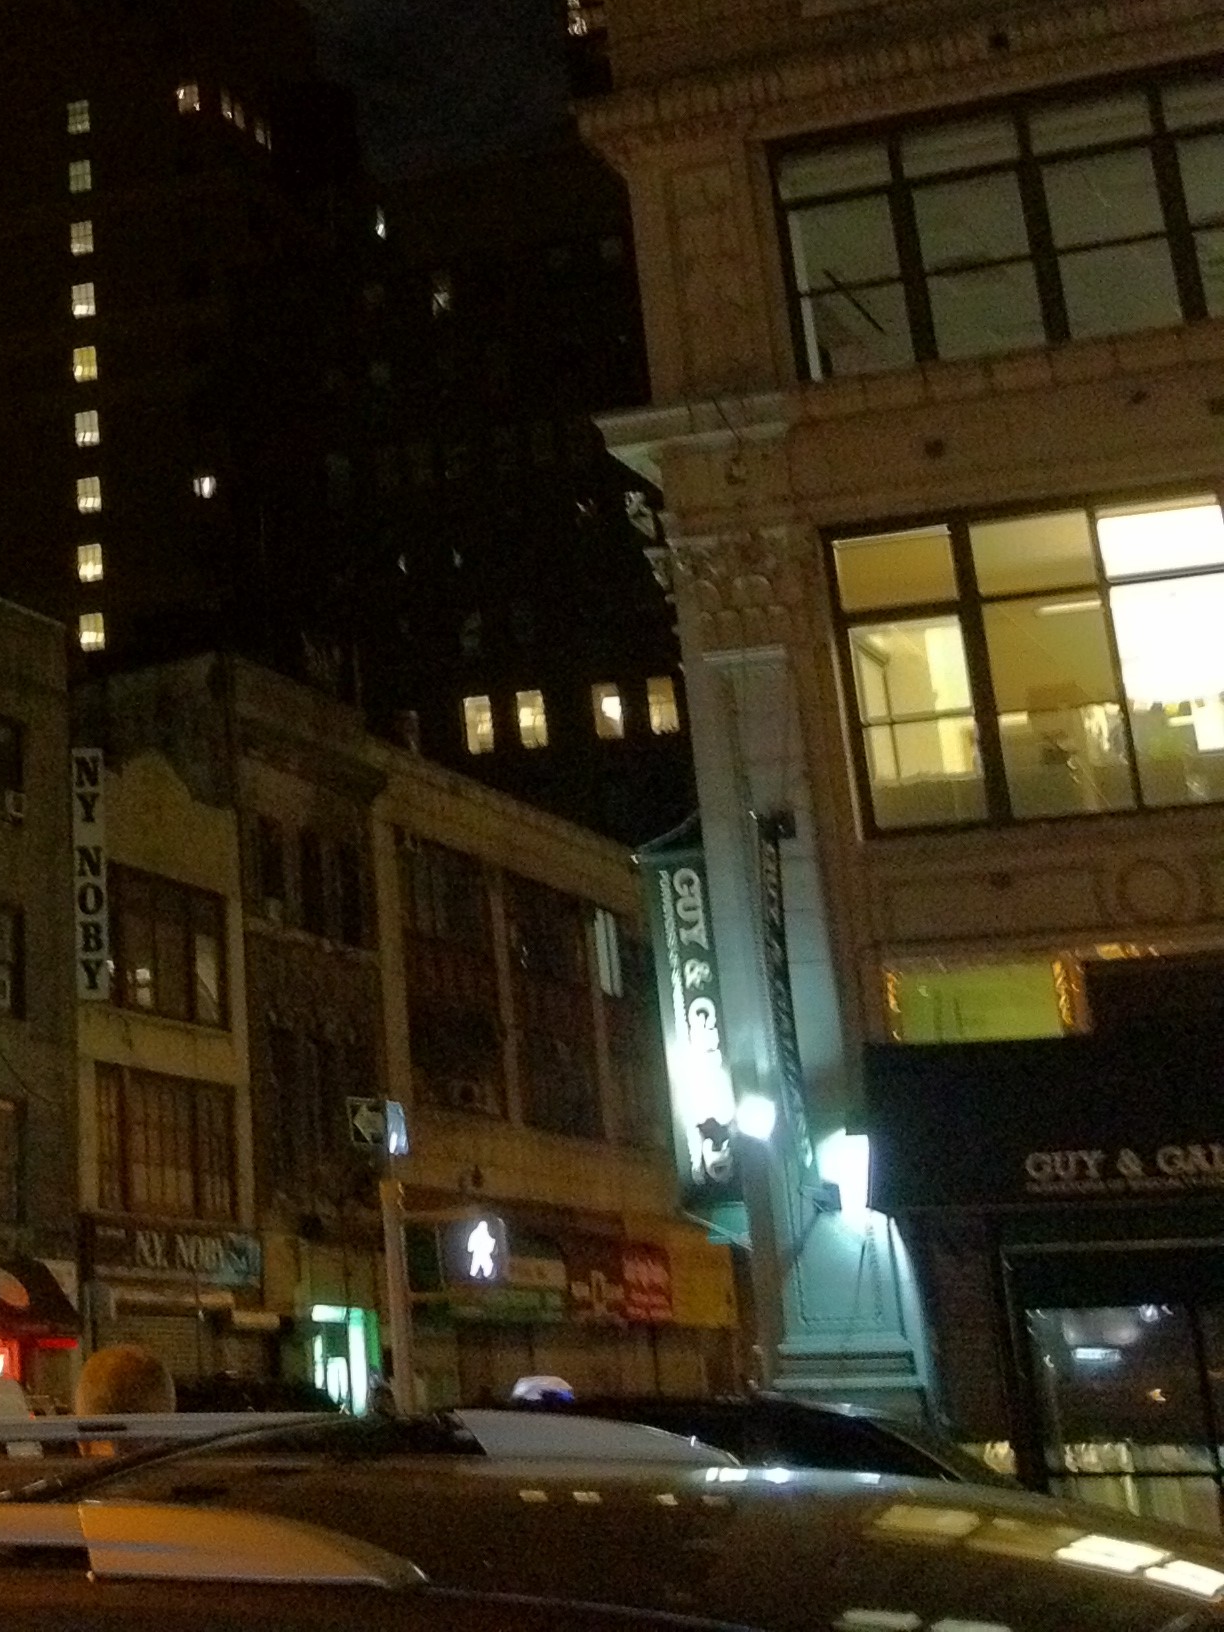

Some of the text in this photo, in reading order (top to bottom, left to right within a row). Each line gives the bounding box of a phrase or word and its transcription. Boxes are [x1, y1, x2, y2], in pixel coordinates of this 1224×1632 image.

[76, 756, 103, 990] NY NOBY
[673, 868, 709, 950] GUY
[684, 958, 713, 990] &
[1025, 1150, 1104, 1180] GUY
[1116, 1148, 1144, 1178] &
